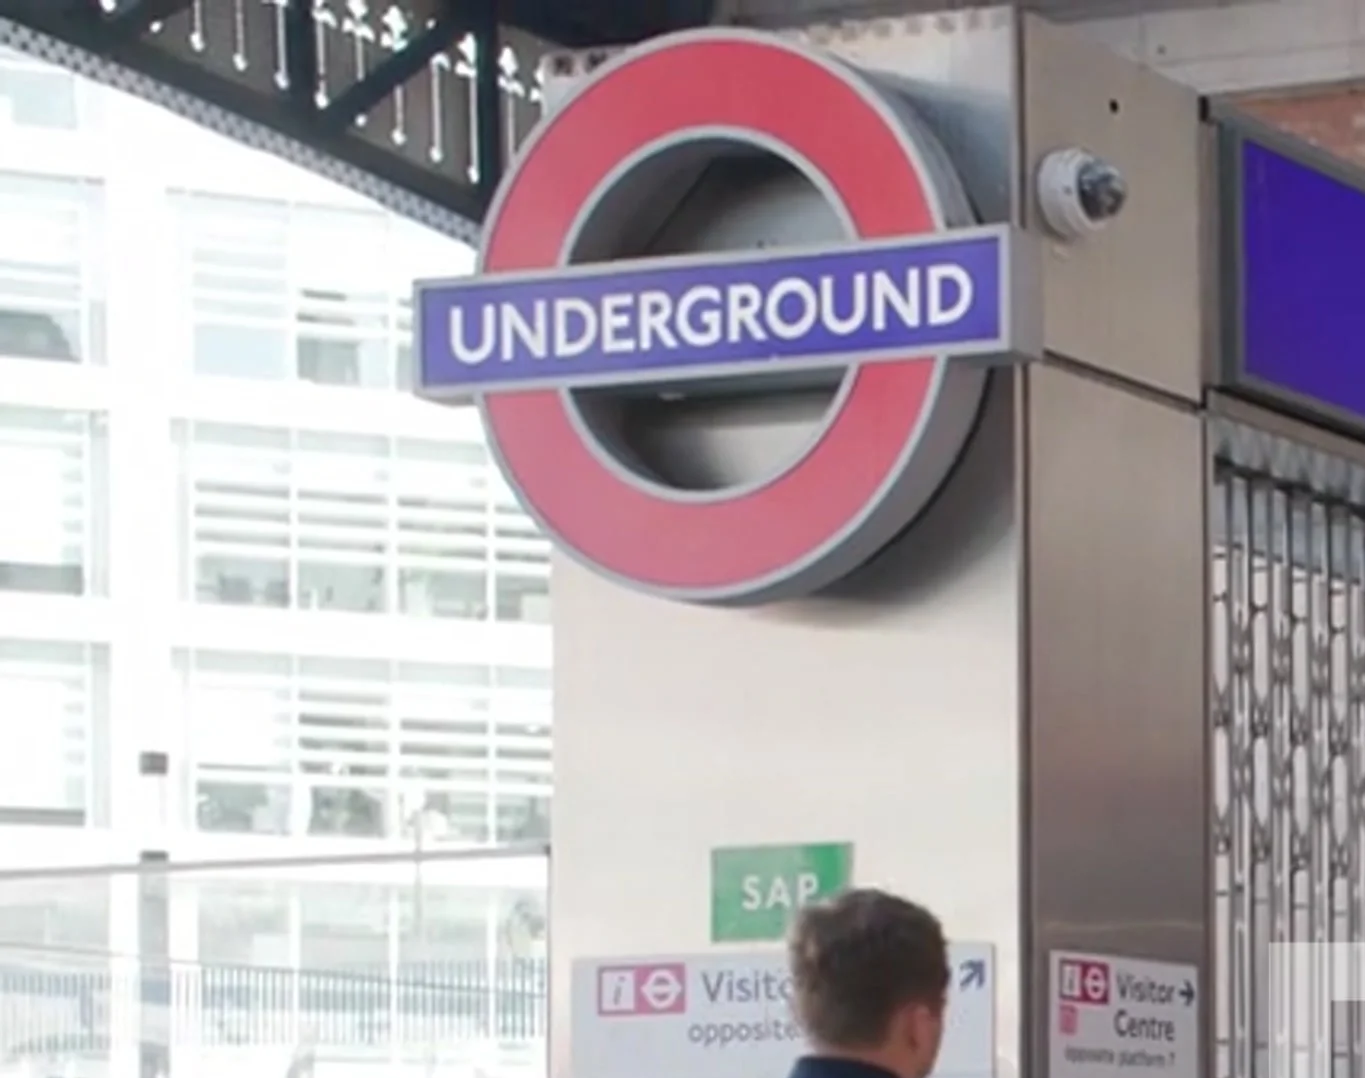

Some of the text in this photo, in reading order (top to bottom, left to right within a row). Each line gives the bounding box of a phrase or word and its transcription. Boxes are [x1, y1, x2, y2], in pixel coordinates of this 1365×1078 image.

[448, 263, 973, 365] UNDERGROUND
[701, 971, 796, 1003] Visito
[1116, 972, 1175, 1003] Visitor
[1113, 1009, 1175, 1041] Centre
